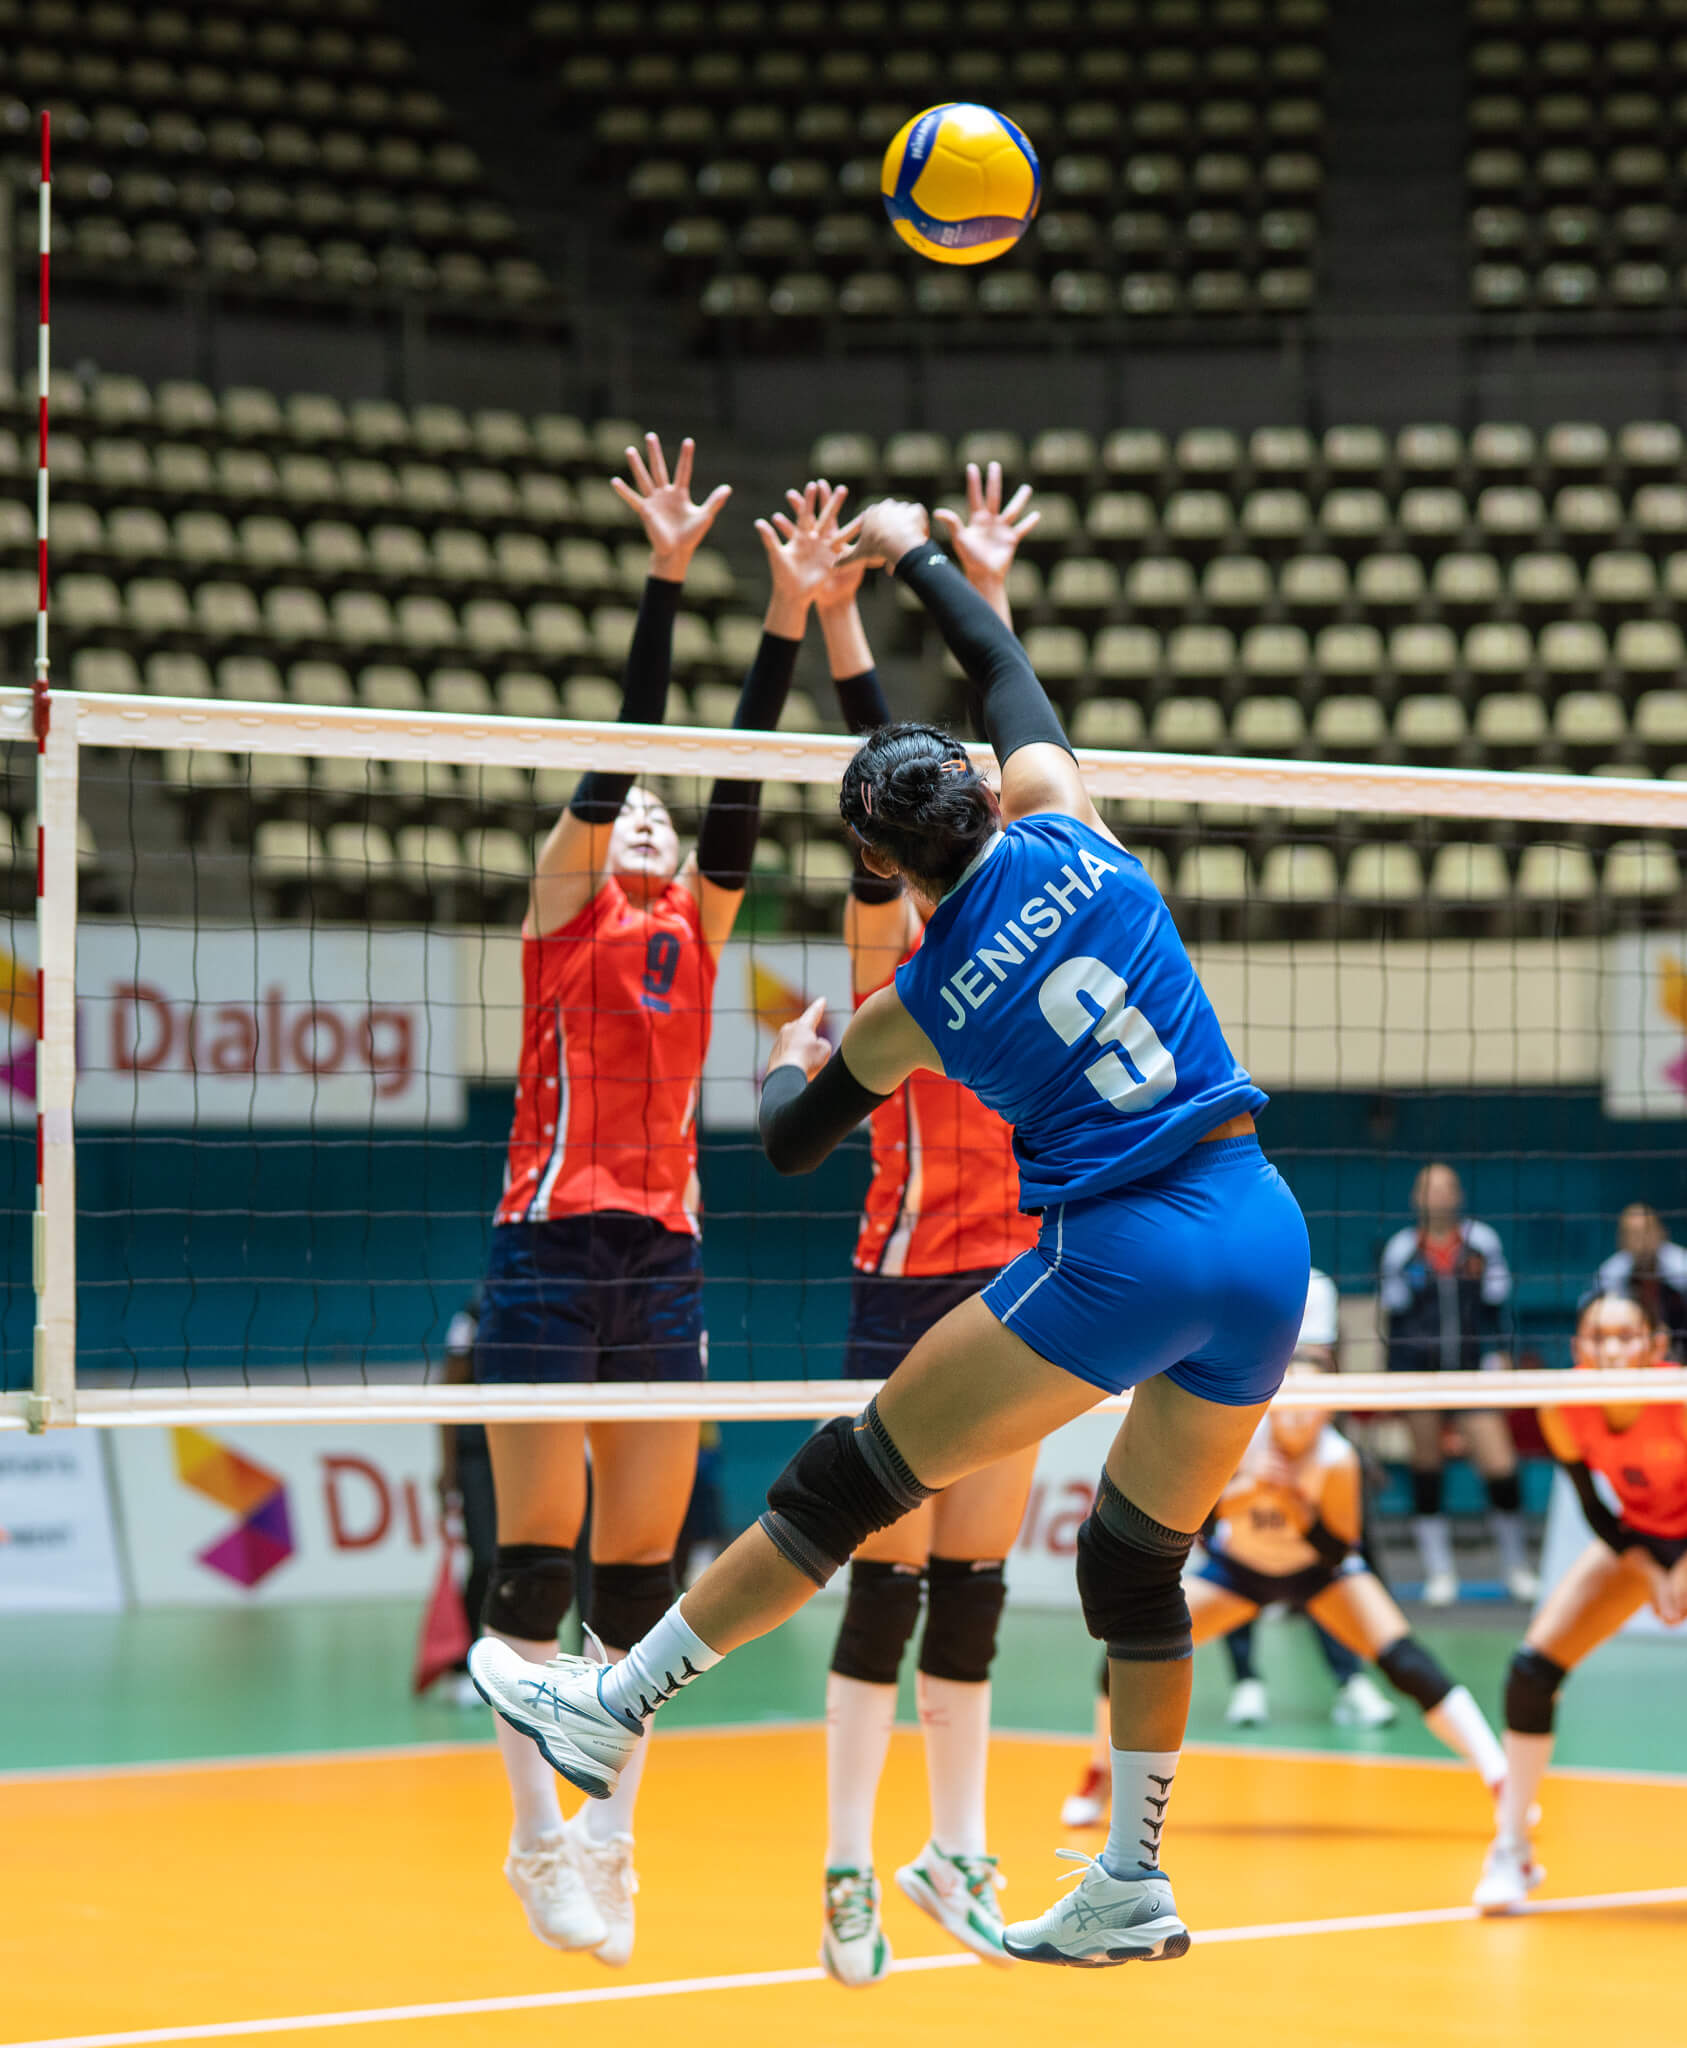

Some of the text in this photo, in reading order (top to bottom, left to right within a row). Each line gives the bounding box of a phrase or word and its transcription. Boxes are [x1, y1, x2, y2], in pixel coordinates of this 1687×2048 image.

[642, 931, 680, 994] 9
[940, 849, 1118, 1031] JENISHA
[1038, 956, 1177, 1113] 3
